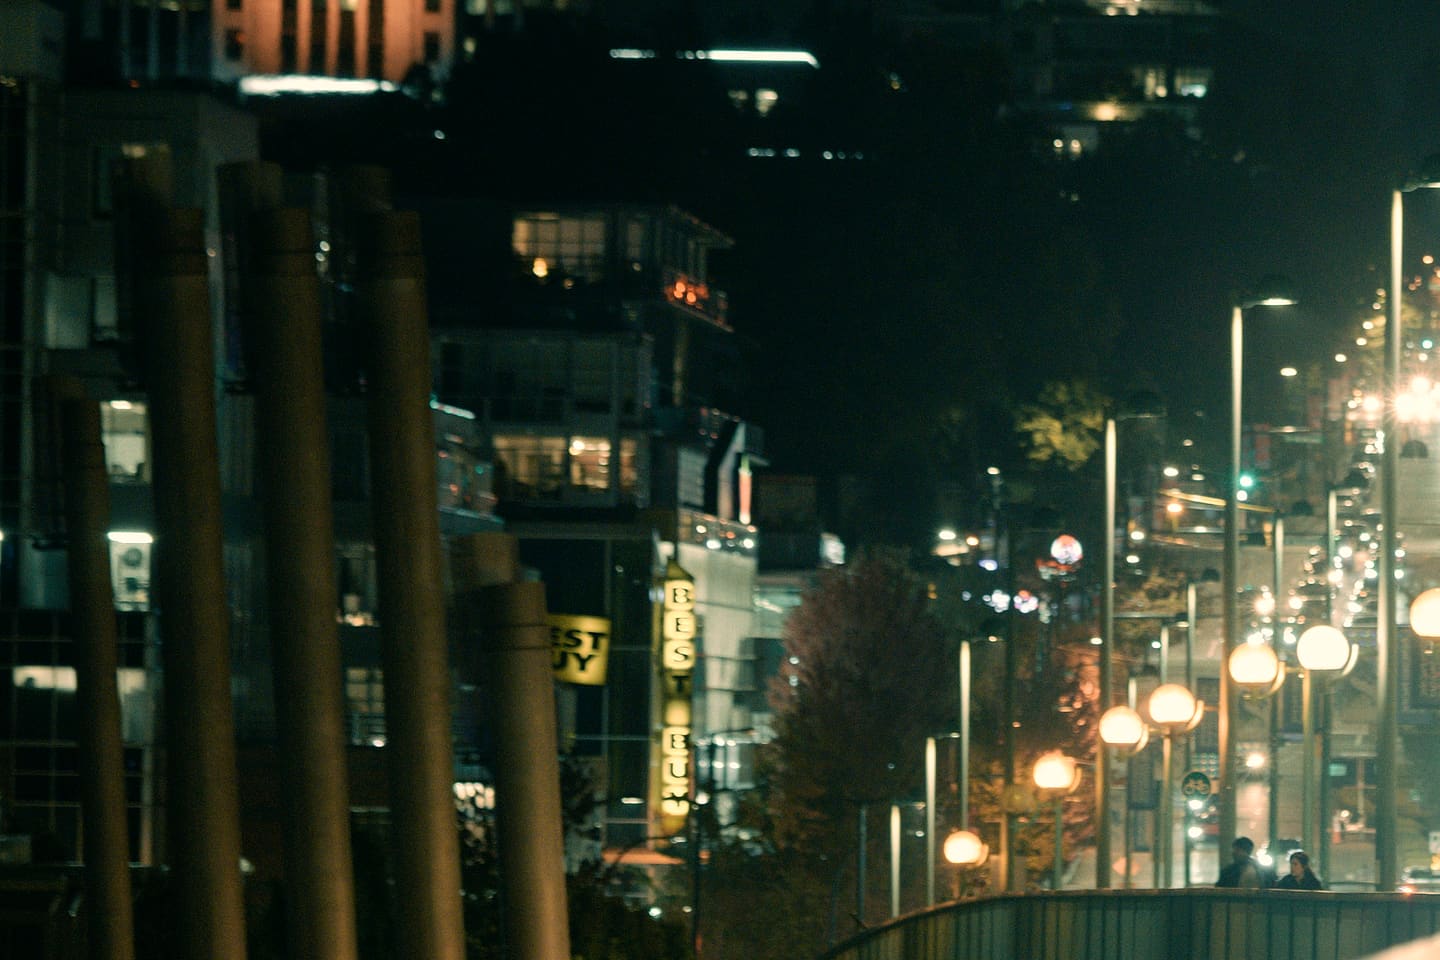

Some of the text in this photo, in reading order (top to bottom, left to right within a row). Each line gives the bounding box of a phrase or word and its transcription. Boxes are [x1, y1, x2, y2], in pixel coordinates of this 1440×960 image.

[550, 626, 608, 650] EST
[552, 650, 597, 672] UY
[669, 587, 690, 807] BEST BUY
